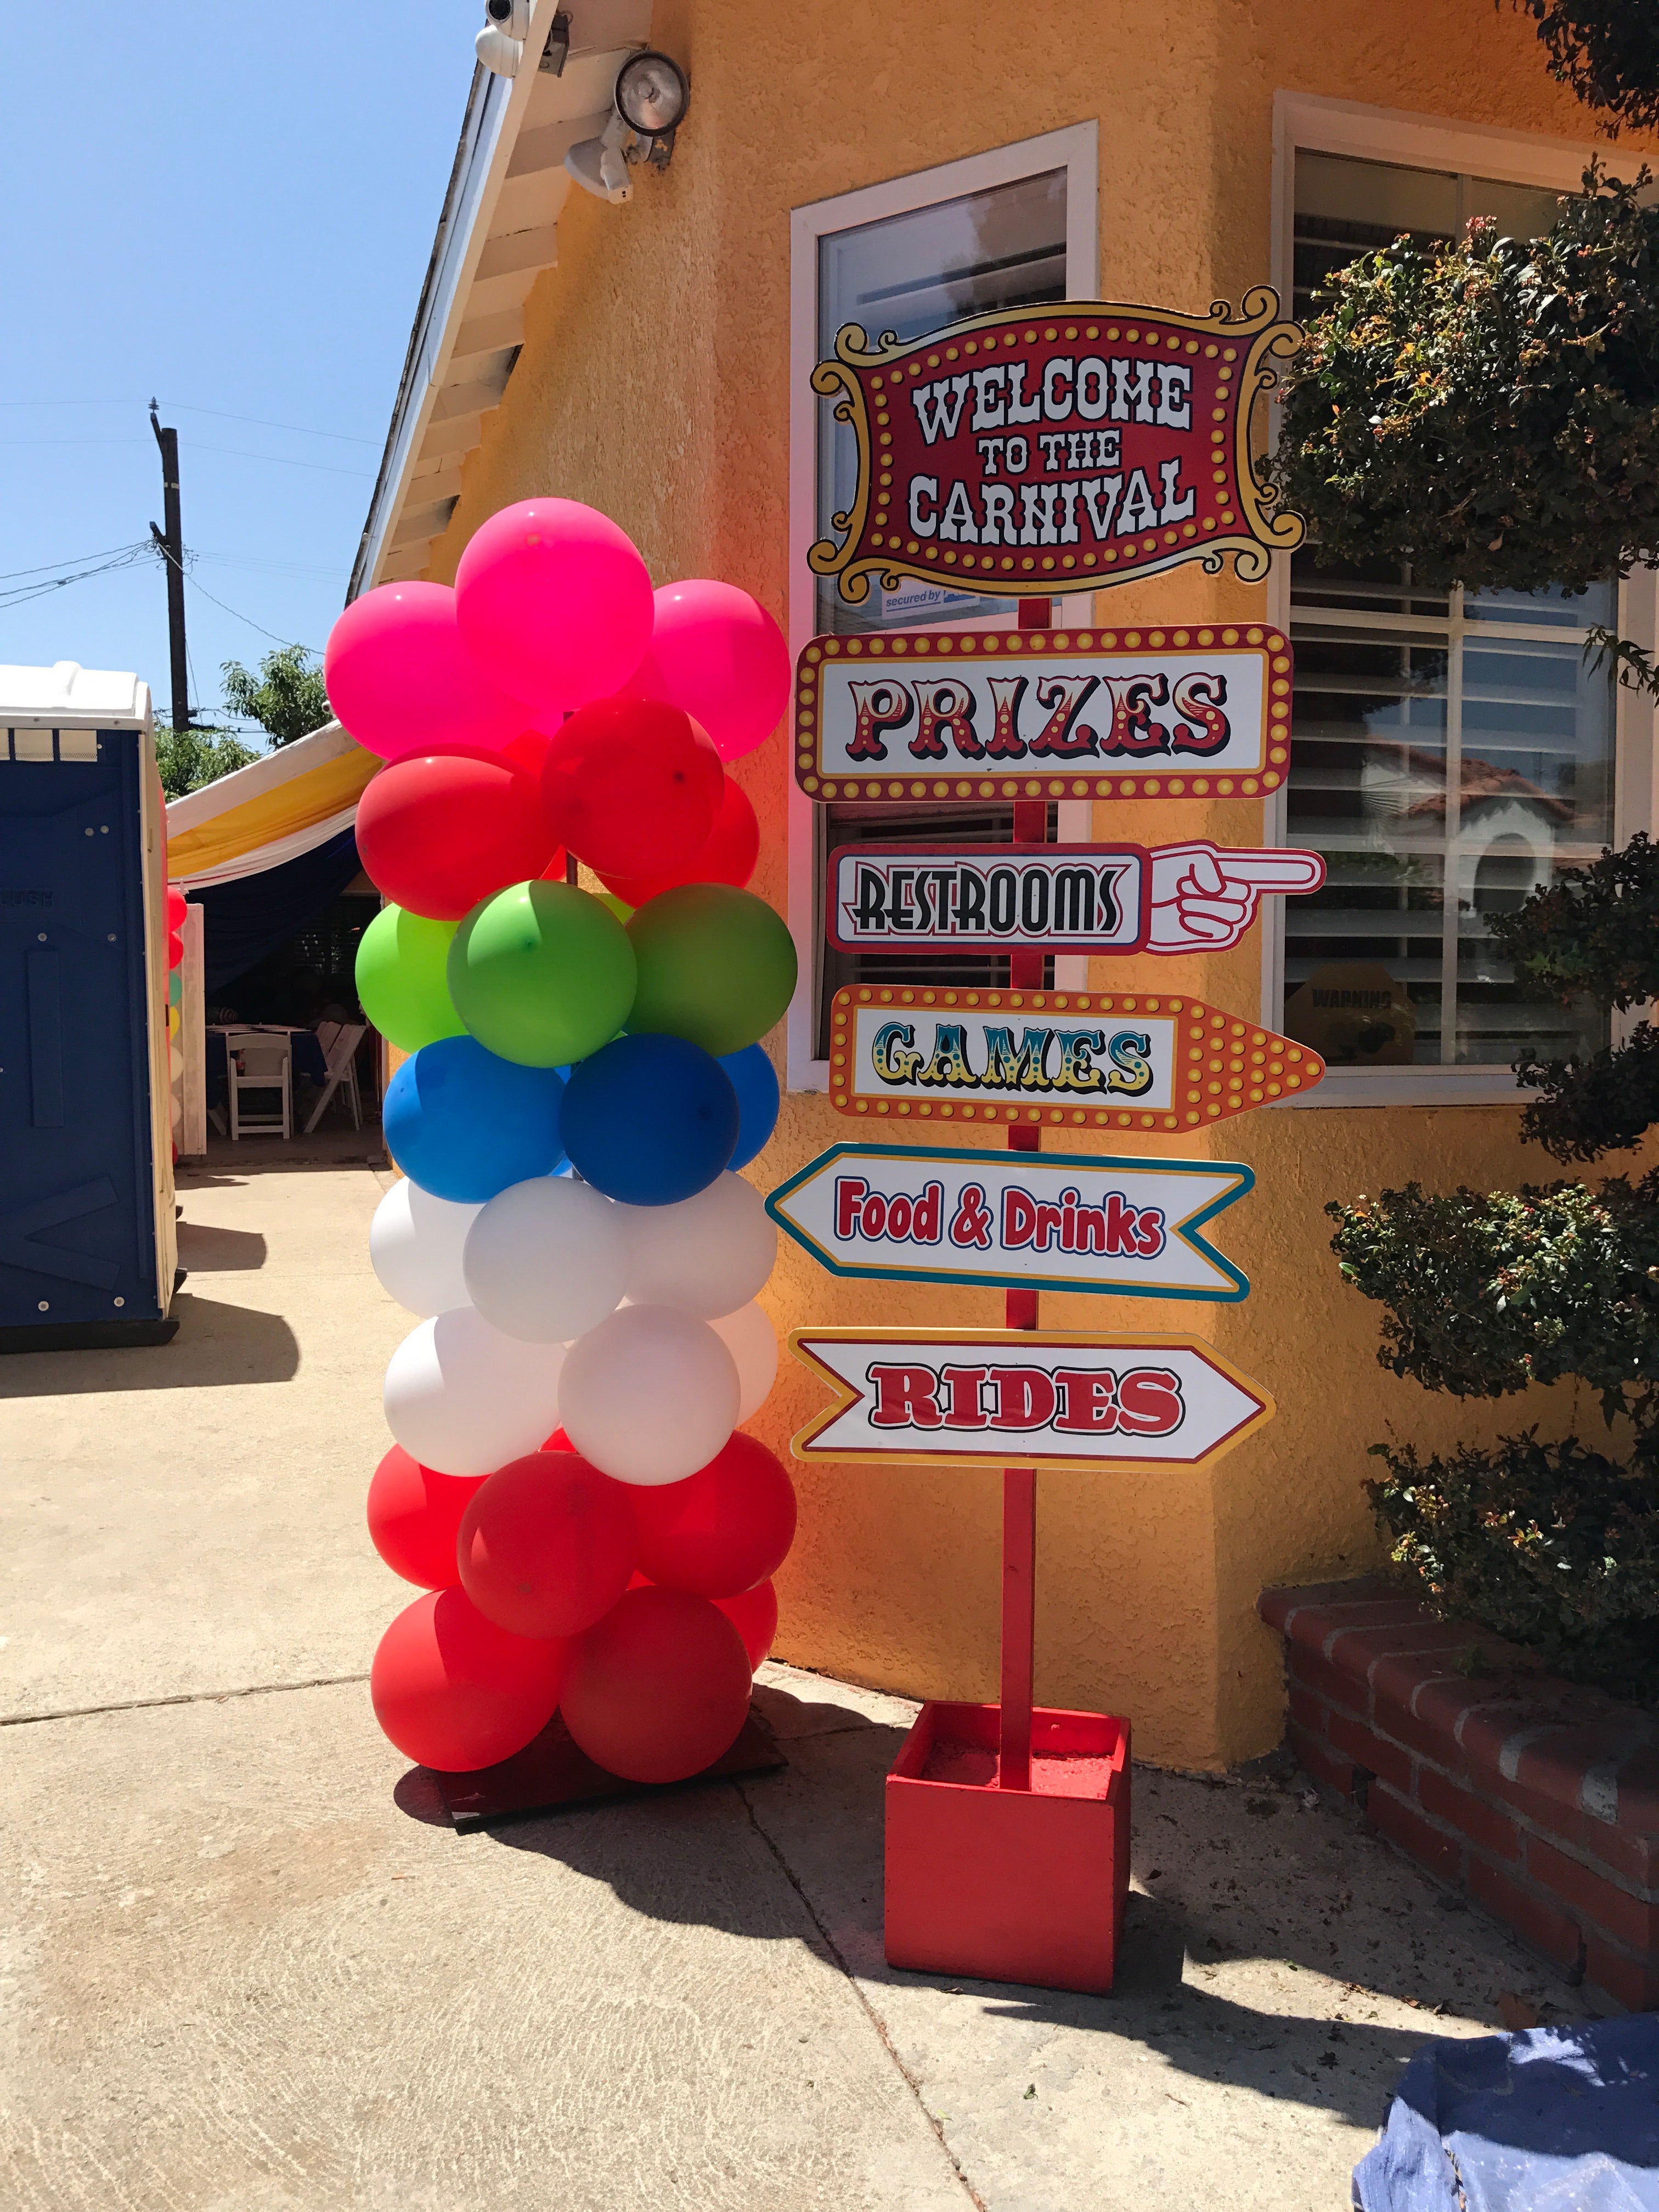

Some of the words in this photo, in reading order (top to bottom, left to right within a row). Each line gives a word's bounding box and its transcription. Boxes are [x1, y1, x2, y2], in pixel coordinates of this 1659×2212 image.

[911, 356, 1192, 445] WELCOME
[978, 437, 1028, 476] TO
[1040, 428, 1122, 471] THE
[908, 458, 1196, 546] CARNIVAL
[886, 591, 926, 607] secured
[928, 590, 941, 601] by
[846, 672, 1231, 761] PRIZES
[849, 864, 1124, 934] RESTROOMS
[1312, 989, 1392, 1009] WARNING
[872, 1023, 1153, 1095] GAMES
[834, 1176, 944, 1243] Food
[949, 1182, 992, 1250] &
[1000, 1186, 1167, 1260] Drinks
[867, 1362, 1185, 1438] RIDES
